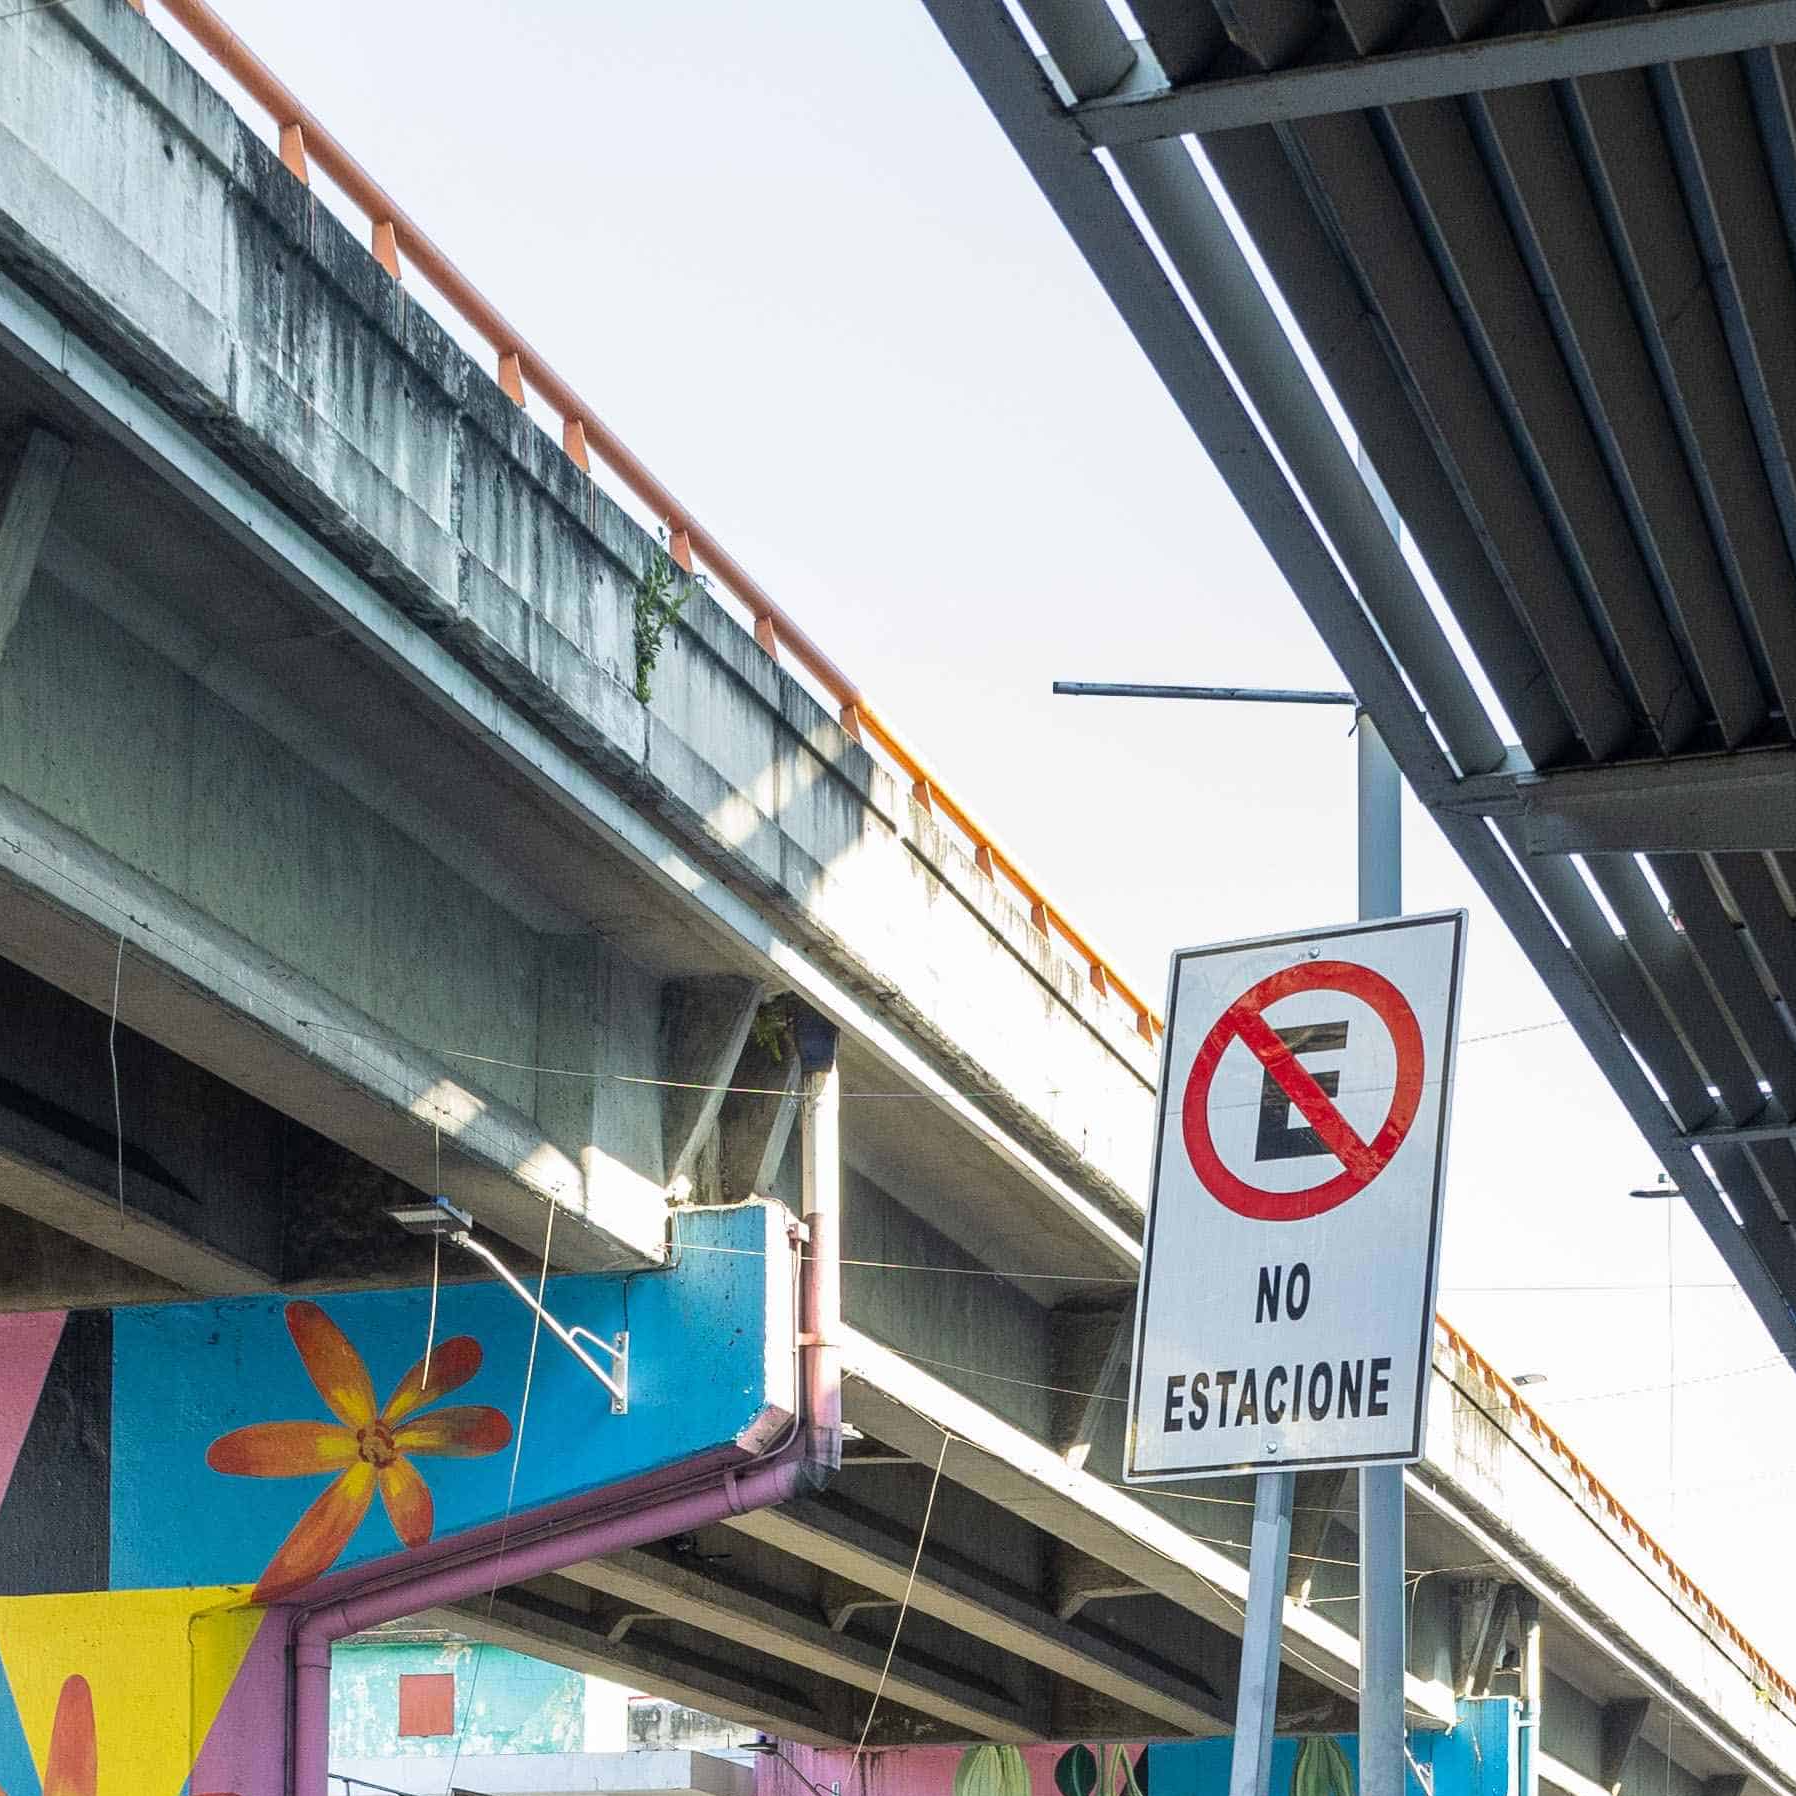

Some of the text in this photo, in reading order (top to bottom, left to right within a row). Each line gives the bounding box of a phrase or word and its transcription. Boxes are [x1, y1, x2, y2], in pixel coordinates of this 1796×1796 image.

[1255, 1021, 1349, 1161] E
[1255, 1263, 1311, 1323] NO
[1164, 1358, 1392, 1433] ESTACIONE
